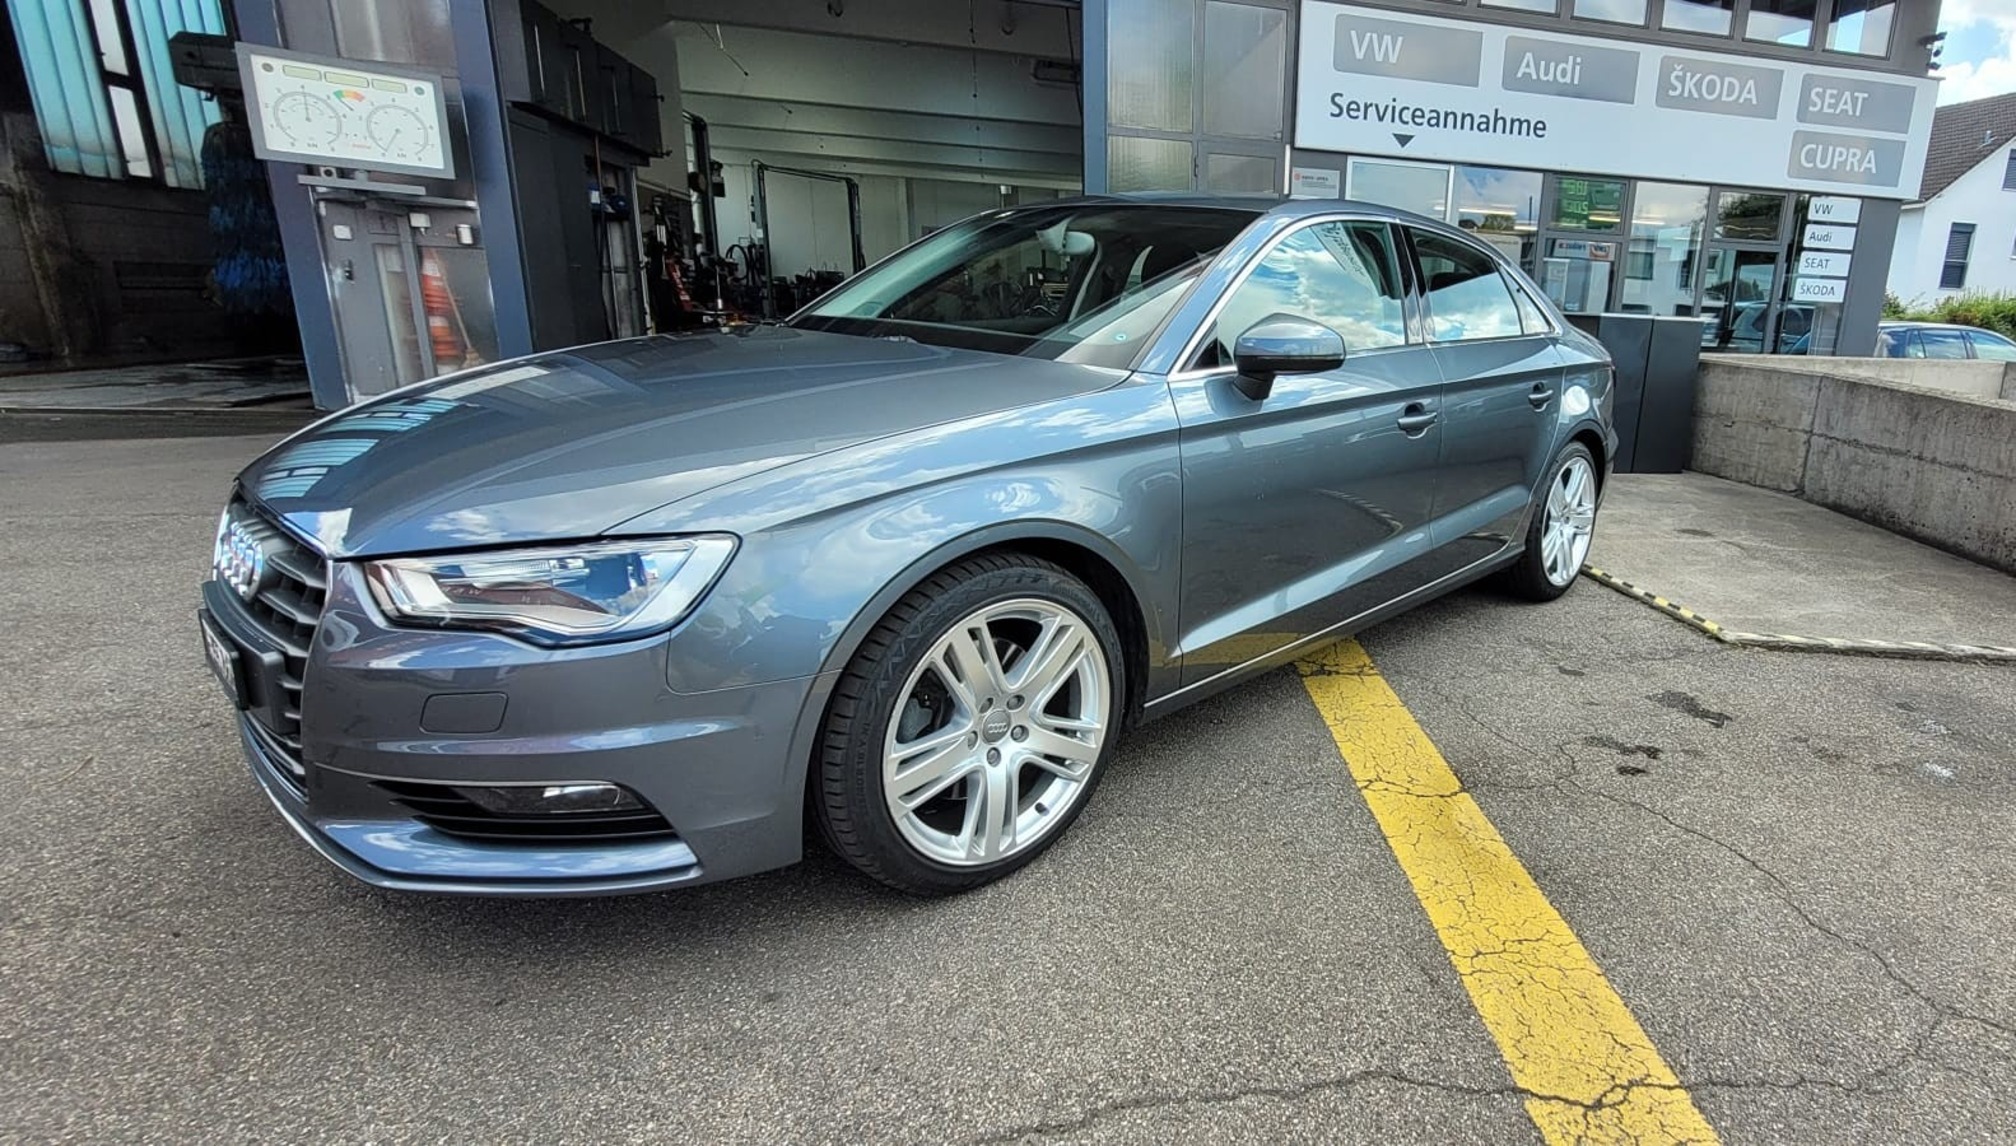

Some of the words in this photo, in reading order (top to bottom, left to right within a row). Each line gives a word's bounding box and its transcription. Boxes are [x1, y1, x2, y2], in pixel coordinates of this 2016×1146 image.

[1349, 29, 1403, 64] VW
[1515, 52, 1582, 86] Audi
[1668, 64, 1757, 105] ŠKODA
[1329, 92, 1547, 138] Serviceannahme
[1808, 87, 1869, 117] SEAT
[1799, 143, 1877, 174] CUPRA
[1814, 203, 1834, 216] VW
[1808, 231, 1833, 243] Audi
[1804, 257, 1831, 269] SEAT
[1799, 280, 1835, 297] ŠKODA
